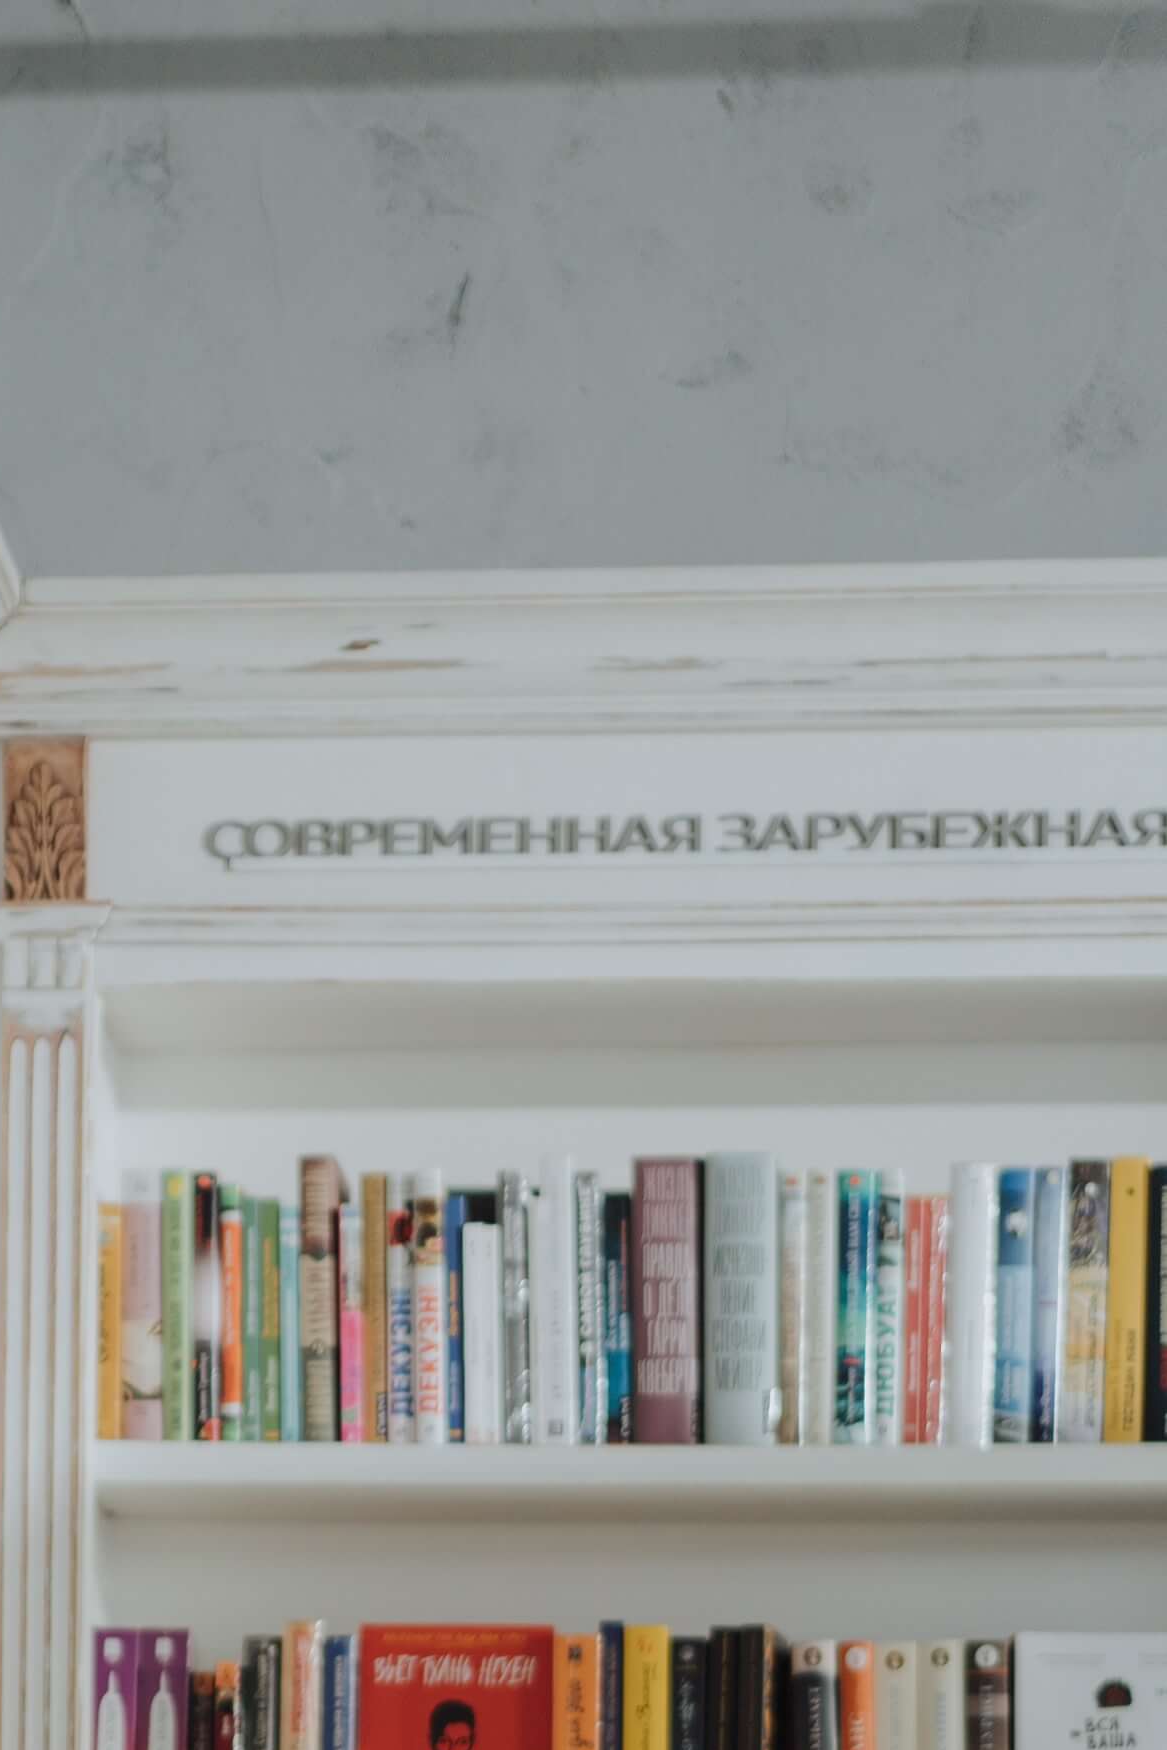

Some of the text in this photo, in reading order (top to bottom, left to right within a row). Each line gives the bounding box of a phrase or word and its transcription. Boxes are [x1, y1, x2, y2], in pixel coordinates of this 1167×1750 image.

[204, 809, 1167, 870] СОВРЕМЕННАЯ ЗАРУБЕЖНАЯ
[1084, 1717, 1120, 1734] ВСЯ
[1085, 1733, 1137, 1750] ВАША
